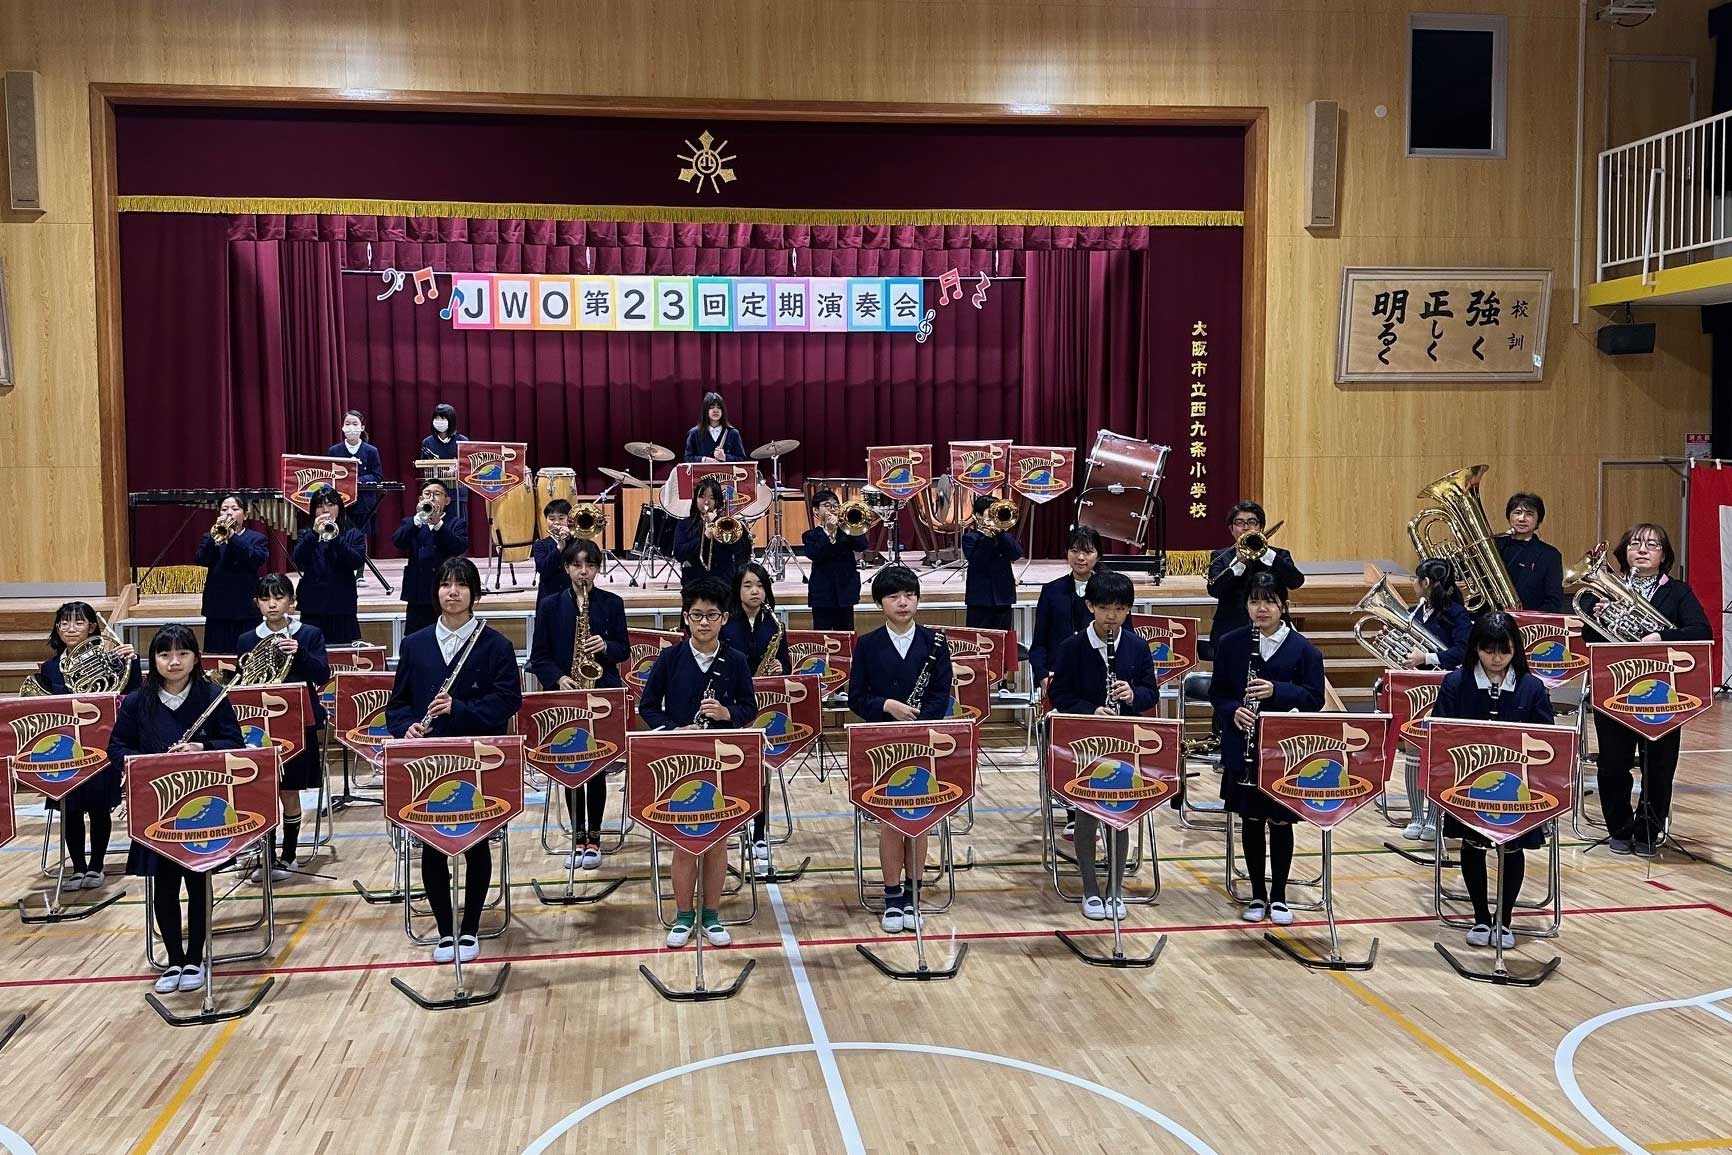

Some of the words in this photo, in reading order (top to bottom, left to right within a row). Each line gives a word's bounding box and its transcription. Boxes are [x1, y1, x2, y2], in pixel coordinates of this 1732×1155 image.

[464, 288, 919, 320] JWO第23回定期演奏会
[1372, 289, 1410, 366] 明るく
[1419, 290, 1454, 363] 正しく
[1466, 289, 1501, 361] 強く
[1507, 300, 1529, 351] 校訓
[1189, 320, 1208, 519] 大阪市立西九条小学校
[1610, 660, 1675, 694] NISHIKUJO
[757, 692, 791, 710] HIKUJO
[1609, 702, 1634, 712] JUNIOR
[1635, 705, 1655, 713] WIND
[1656, 701, 1696, 712] ORCHESTRA
[12, 713, 79, 752] NISHIKUJO
[534, 707, 594, 743] NISHIKUJO
[12, 761, 38, 771] JUNIOR
[39, 762, 59, 771] WIND
[60, 755, 101, 769] ORCHESTRA
[869, 743, 936, 784] NISHIKUJO
[1281, 736, 1347, 774] NISHIKUJO
[1450, 745, 1528, 784] NISHIKUJO
[151, 770, 234, 817] NISHIKUJO
[406, 755, 482, 798] NISHIKUJO
[650, 755, 721, 797] NISHIKUJO
[1070, 787, 1096, 798] JUNIOR
[1097, 791, 1118, 799] WIND
[1119, 787, 1162, 799] ORCHESTRA
[1278, 785, 1304, 797] JUNIOR
[1305, 789, 1324, 798] WIND
[1325, 785, 1367, 797] ORCHESTRA
[405, 812, 434, 822] JUNIOR
[435, 814, 457, 822] WIND
[458, 807, 505, 821] ORCHESTRA
[648, 811, 677, 821] JUNIOR
[677, 813, 699, 822] WIND
[699, 807, 744, 821] ORCHESTRA
[868, 796, 894, 806] JUNIOR
[895, 798, 915, 806] WIND
[915, 791, 957, 805] ORCHESTRA
[1449, 795, 1477, 808] JUNIOR
[1478, 801, 1501, 811] WIND
[1502, 800, 1551, 811] ORCHESTRA
[152, 829, 183, 841] JUNIOR
[184, 829, 208, 840] WIND
[209, 819, 259, 838] ORCHESTRA
